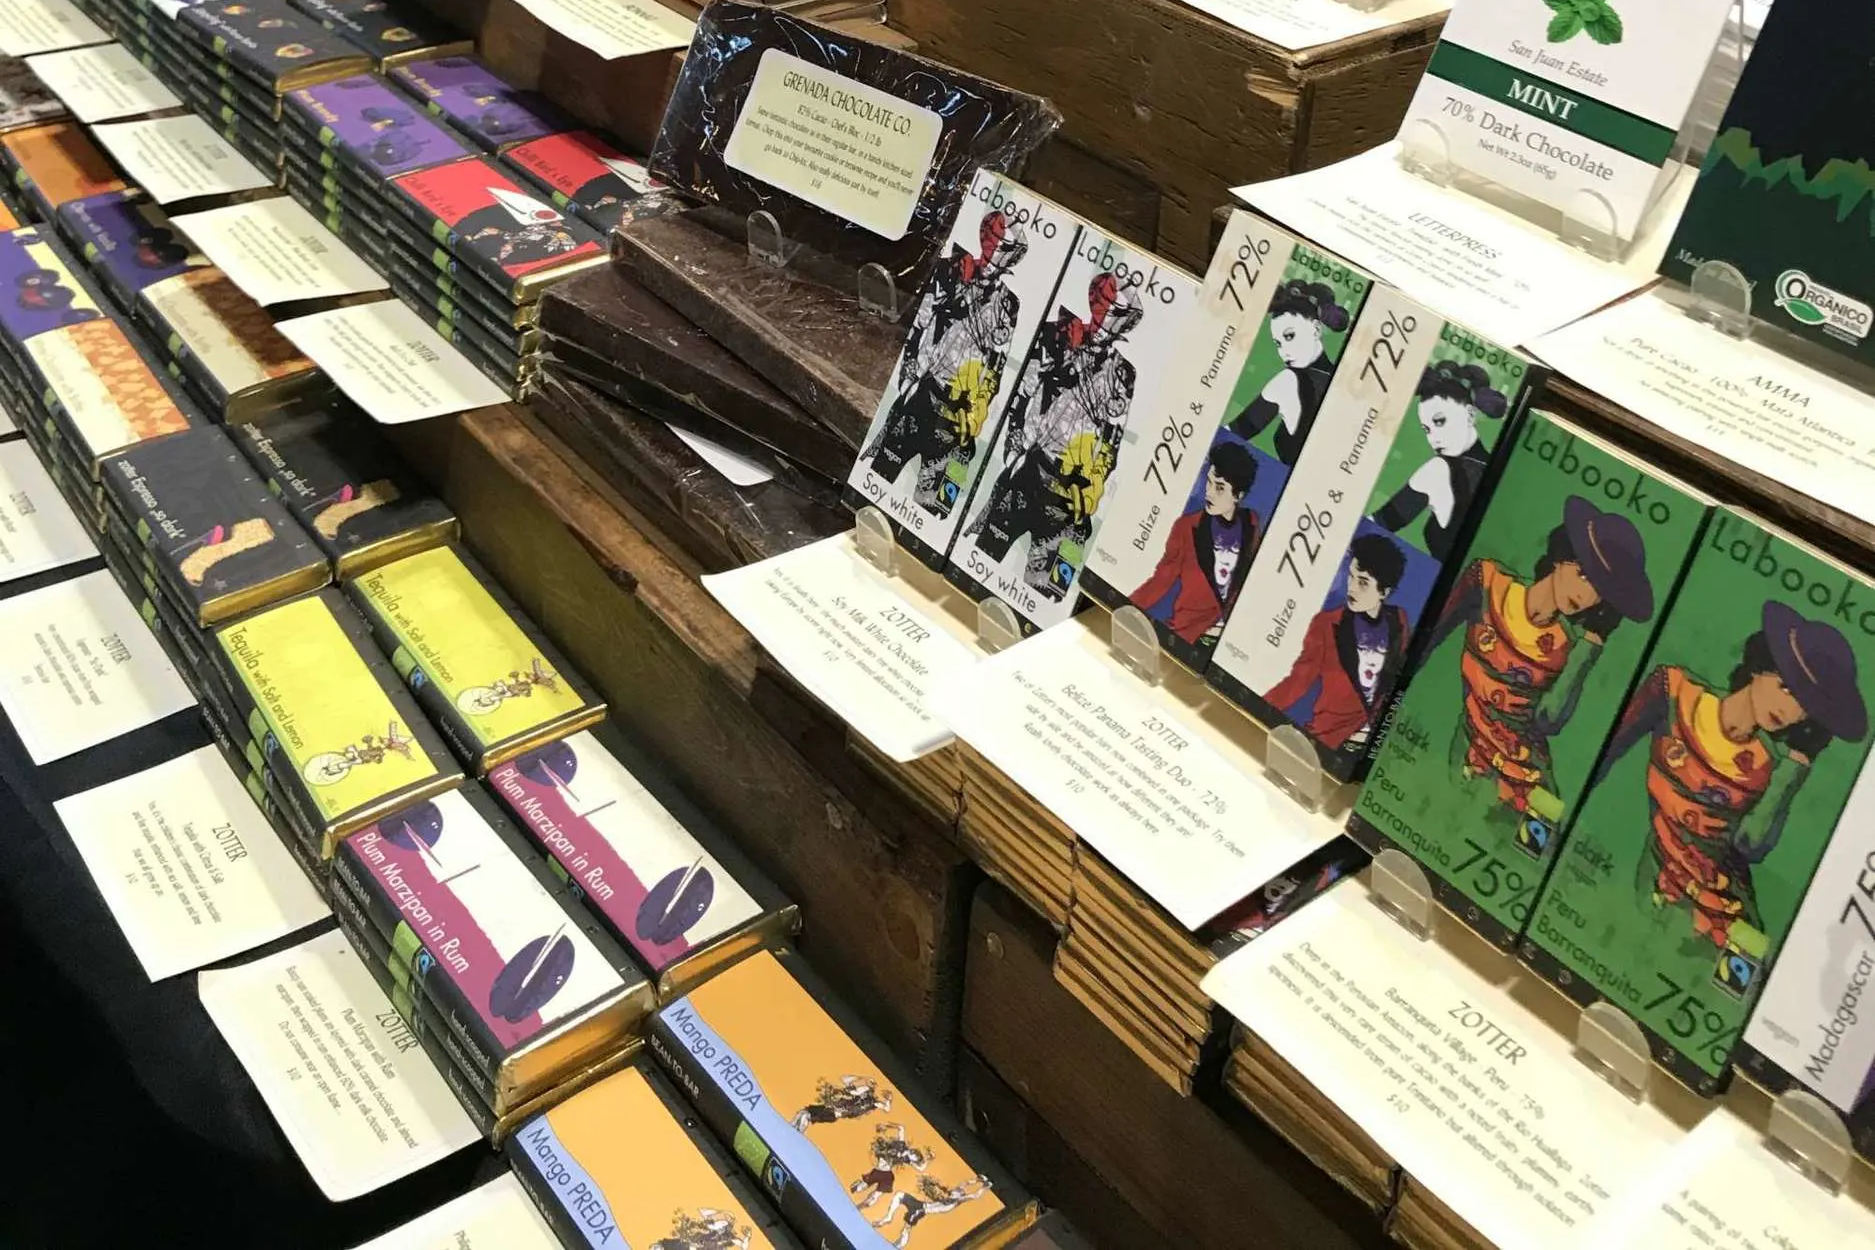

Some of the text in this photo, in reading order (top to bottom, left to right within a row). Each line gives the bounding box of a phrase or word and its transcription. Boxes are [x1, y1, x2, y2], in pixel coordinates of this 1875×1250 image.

[1507, 39, 1609, 88] San Juan Estate
[783, 71, 912, 137] GRENADA CHOCOLATE CO.
[1506, 78, 1580, 121] MINT
[1441, 96, 1615, 182] 70% Dark Chocolate
[1478, 138, 1494, 152] Net
[969, 172, 1058, 240] Labooko
[1407, 211, 1498, 260] LETTERPRESS
[1076, 231, 1176, 305] Labooko
[1219, 234, 1272, 313] 72%
[1291, 247, 1364, 295] Labooko
[1787, 277, 1869, 325] ORGÂNICO
[1830, 314, 1864, 334] BRASIL
[1358, 309, 1419, 396] 72%
[1440, 320, 1522, 378] Labooko
[1660, 352, 1700, 375] Cacao
[1746, 374, 1811, 408] AMMA
[884, 446, 902, 464] vegan
[1132, 324, 1237, 552] Belize 72% & Panama
[862, 472, 925, 530] Soy white
[1522, 419, 1670, 525] Labooko
[989, 523, 1010, 542] vegan
[1266, 406, 1380, 648] Belize 72% & Panama
[967, 549, 1037, 613] Soy white
[1711, 516, 1875, 636] Labooko
[365, 573, 402, 612] Tequila
[407, 627, 425, 643] Salt
[419, 642, 436, 659] and
[430, 652, 454, 683] Lemon
[864, 621, 891, 645] White
[887, 641, 929, 676] Chocolate
[880, 606, 931, 643] ZOTTER
[229, 627, 304, 749] Tequila with Salt and Lemon
[1141, 716, 1190, 752] ZOTTER
[1395, 720, 1430, 752] dark
[1130, 734, 1229, 816] Tasting Duo 72%
[1372, 766, 1406, 802] Peru
[212, 822, 248, 862] ZOTTER
[496, 768, 615, 901] Plum Marzipan in Rum
[1361, 791, 1536, 924] Barranquita 75%
[1572, 840, 1615, 877] dark
[357, 832, 470, 974] Plum Marzipan in Rum
[1550, 889, 1587, 930] Peru
[1536, 914, 1741, 1067] Barranquita 75%
[1804, 950, 1875, 1084] Madagascar
[375, 1008, 420, 1054] ZOTTER
[669, 1007, 764, 1112] Mango PREDA
[1384, 986, 1442, 1036] Barranquita
[1443, 1031, 1478, 1066] Village
[1483, 1065, 1510, 1092] Peru
[1447, 1000, 1528, 1066] ZOTTER
[651, 1033, 701, 1101] BEAN-TO-BAR
[528, 1127, 572, 1187] Mango
[567, 1180, 617, 1246] PREDA
